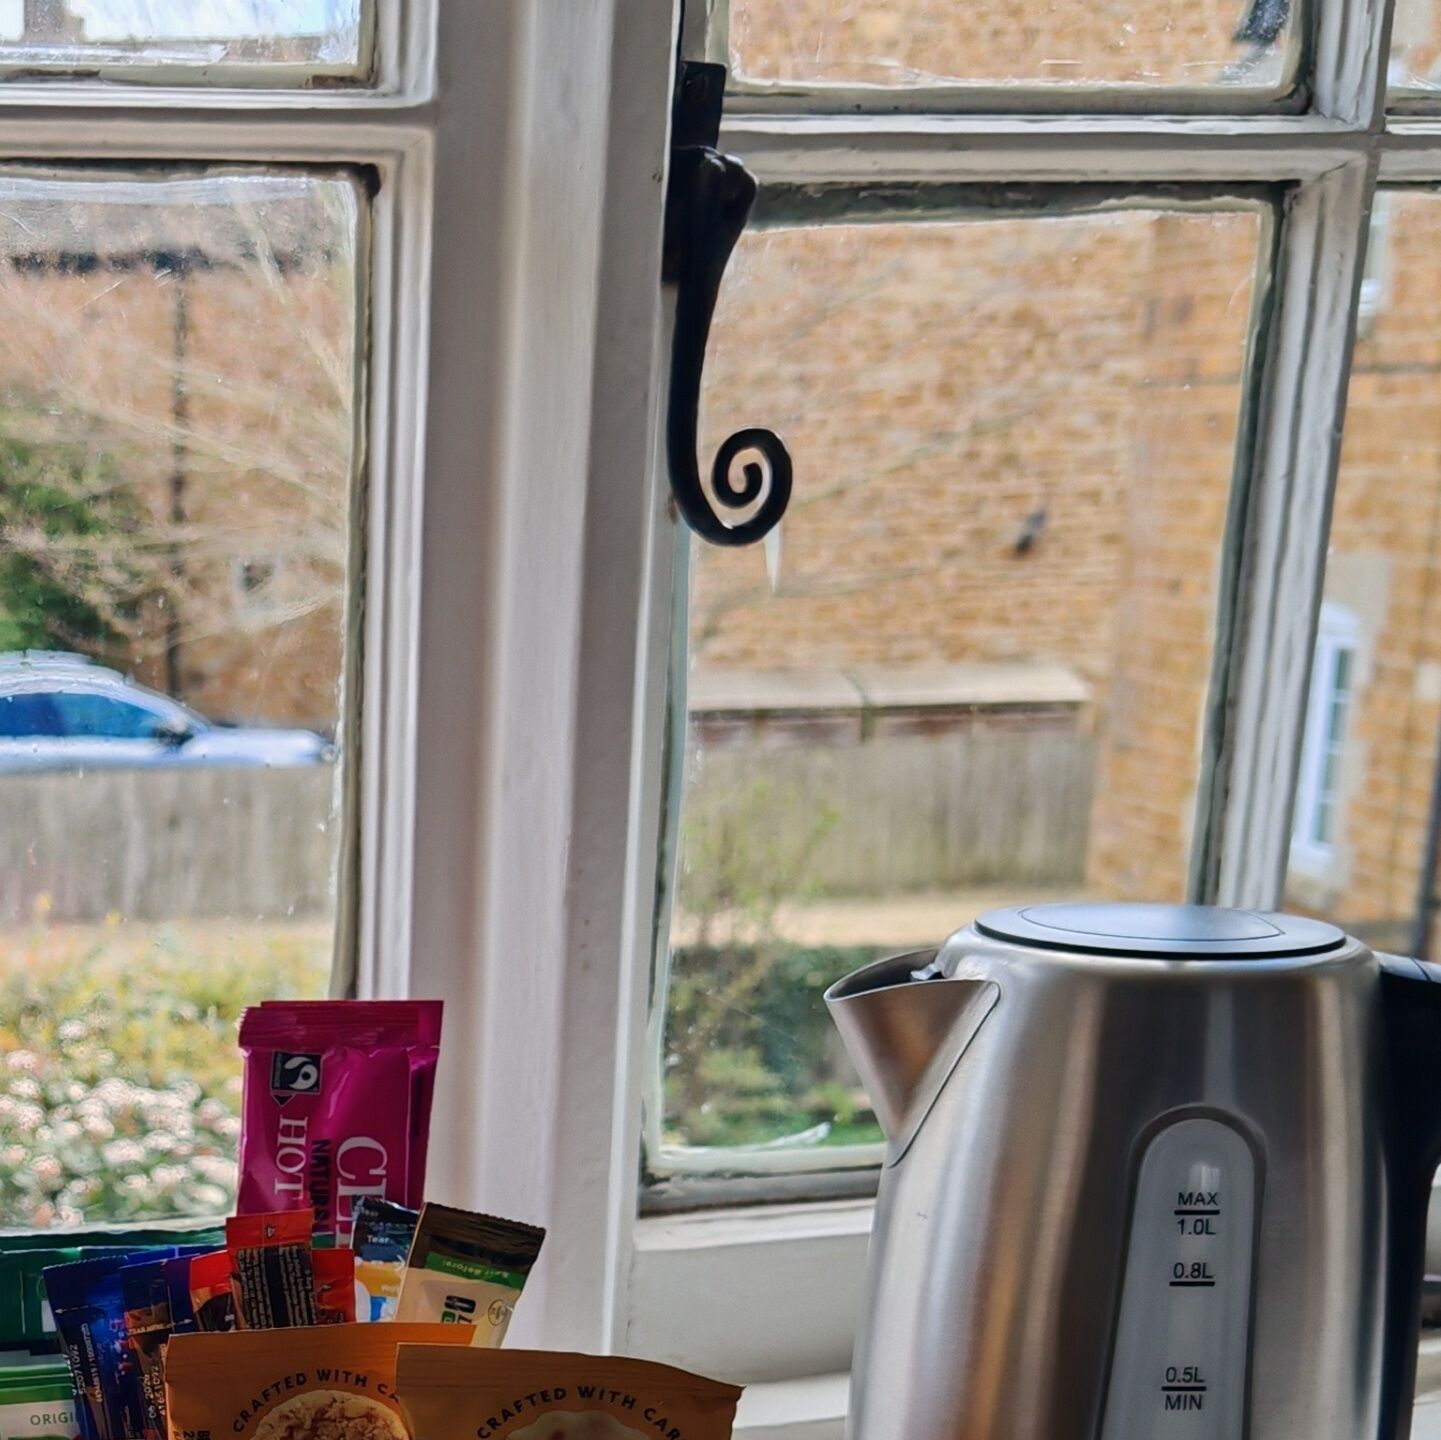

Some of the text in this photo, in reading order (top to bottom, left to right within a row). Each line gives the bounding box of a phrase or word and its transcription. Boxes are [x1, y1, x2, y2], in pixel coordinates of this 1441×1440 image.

[274, 1114, 309, 1200] HOT
[1176, 1191, 1219, 1207] MAX
[1176, 1218, 1217, 1236] 1.0L
[367, 1234, 390, 1244] Tear
[1172, 1261, 1214, 1280] 0.8L
[1165, 1366, 1205, 1384] 0.5L
[233, 1372, 307, 1432] CRAFTED
[316, 1368, 368, 1388] WITH
[1164, 1394, 1203, 1411] MIN
[476, 1387, 567, 1440] CRAFTED
[577, 1385, 636, 1410] WITH
